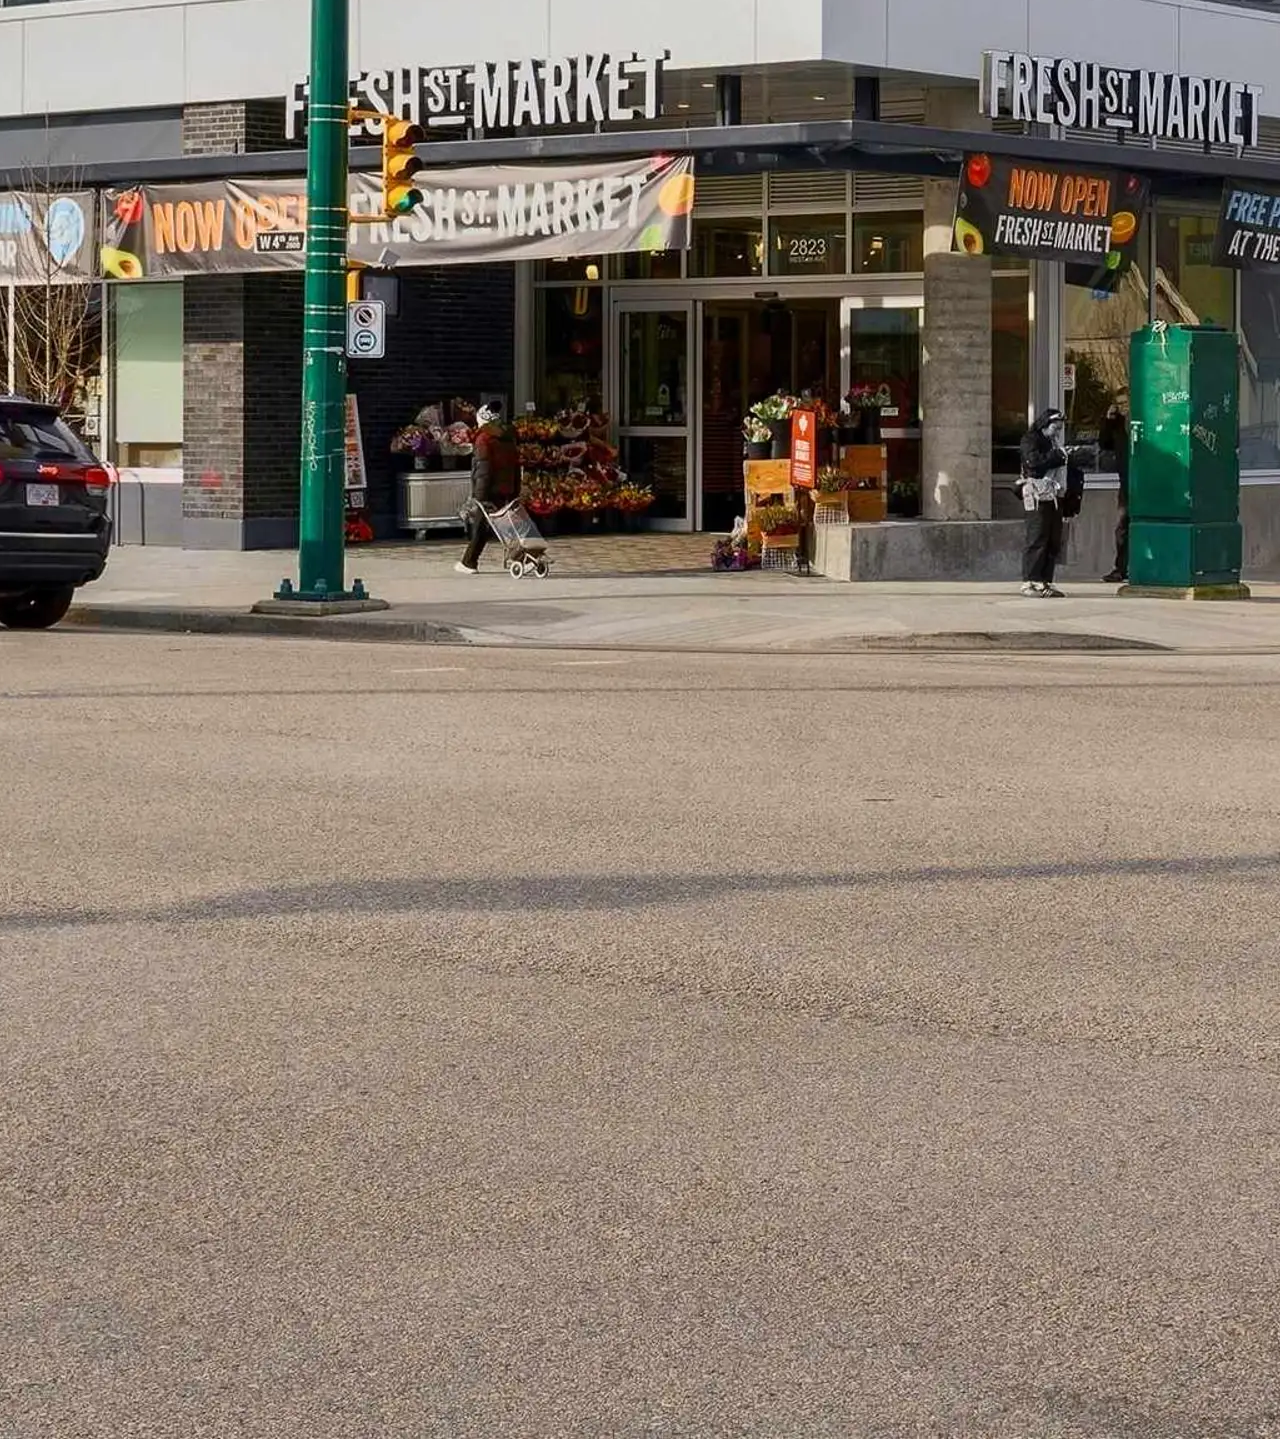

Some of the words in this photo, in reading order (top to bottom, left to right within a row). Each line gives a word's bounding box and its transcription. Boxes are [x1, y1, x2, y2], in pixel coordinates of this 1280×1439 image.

[472, 59, 664, 129] MARKET
[990, 50, 1100, 129] FRESH
[1138, 69, 1264, 147] MARKET
[1008, 168, 1058, 211] NOW
[1060, 175, 1111, 217] OPEN
[1226, 189, 1270, 226] FREE
[152, 199, 226, 254] NOW
[496, 174, 646, 238] MARKET
[994, 214, 1043, 247] FRESH
[1053, 221, 1113, 253] MARKET
[260, 235, 271, 249] W
[790, 238, 826, 256] 2823
[1228, 229, 1252, 257] AT
